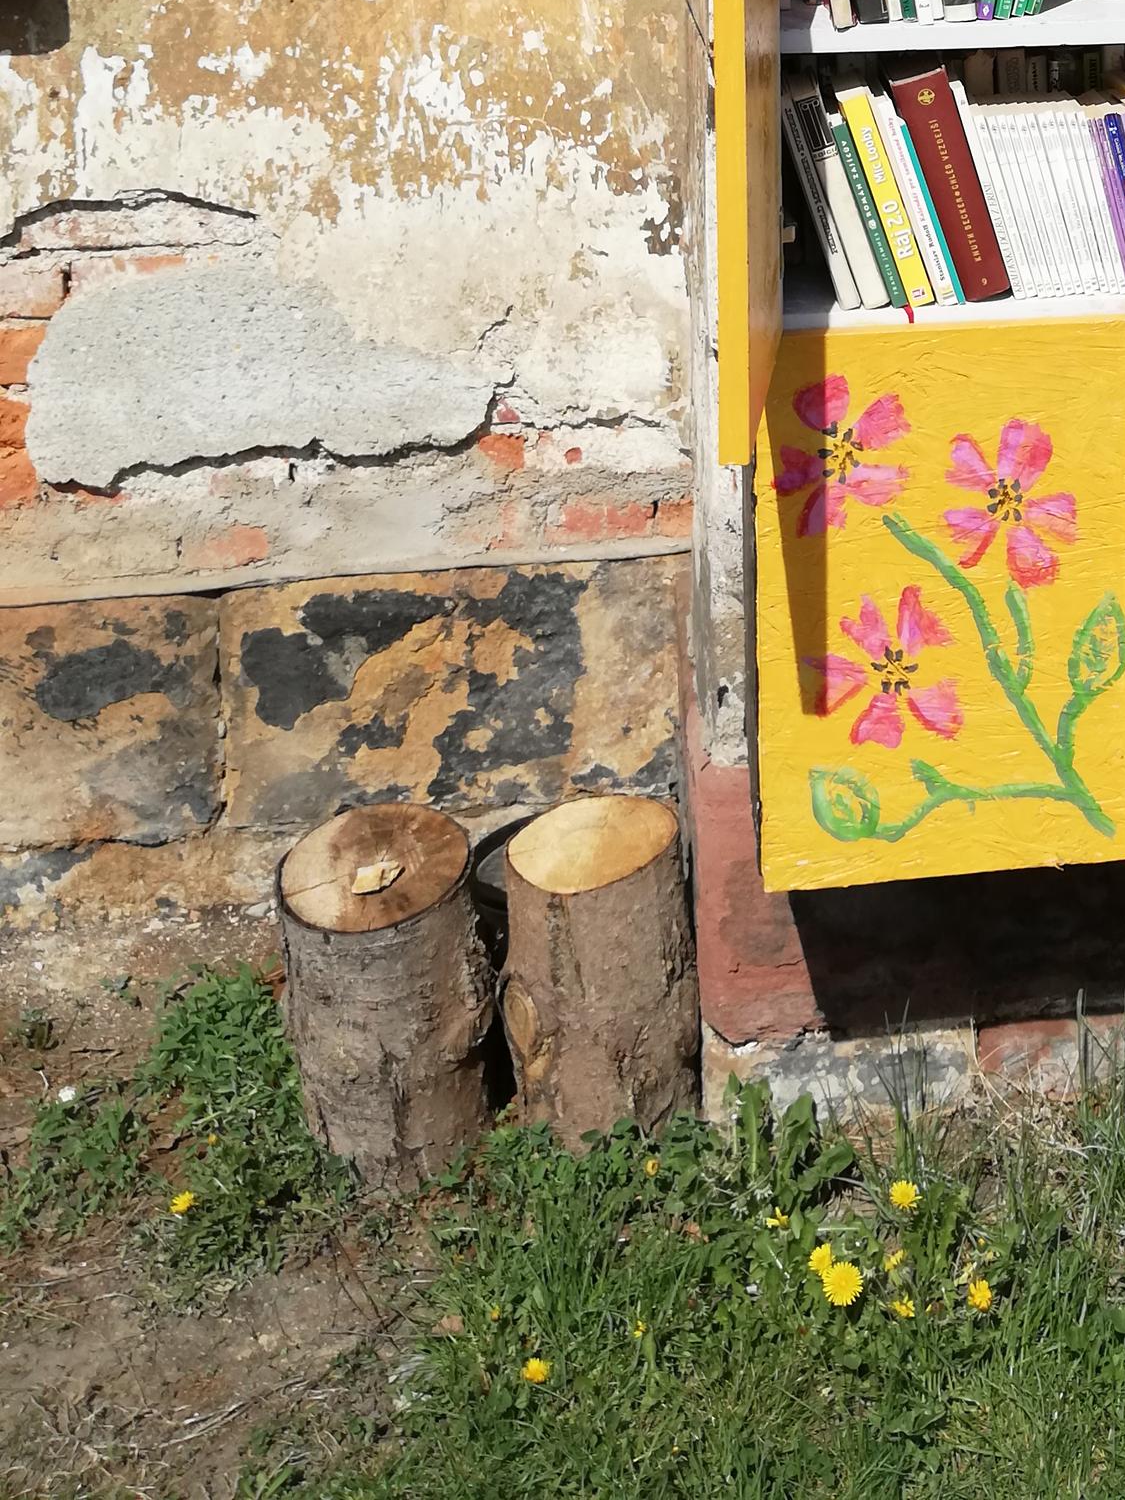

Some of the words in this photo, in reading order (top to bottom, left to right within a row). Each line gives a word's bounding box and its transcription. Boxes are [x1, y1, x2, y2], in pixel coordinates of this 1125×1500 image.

[858, 123, 879, 162] Looby
[870, 160, 887, 185] Mic
[854, 181, 872, 218] ROMÁN
[882, 197, 903, 229] 2.0
[953, 195, 972, 231] BECKER
[892, 227, 914, 260] Ráj
[922, 221, 934, 248] Rudolf
[965, 231, 982, 263] KNUTH
[931, 248, 946, 282] Stanislav
